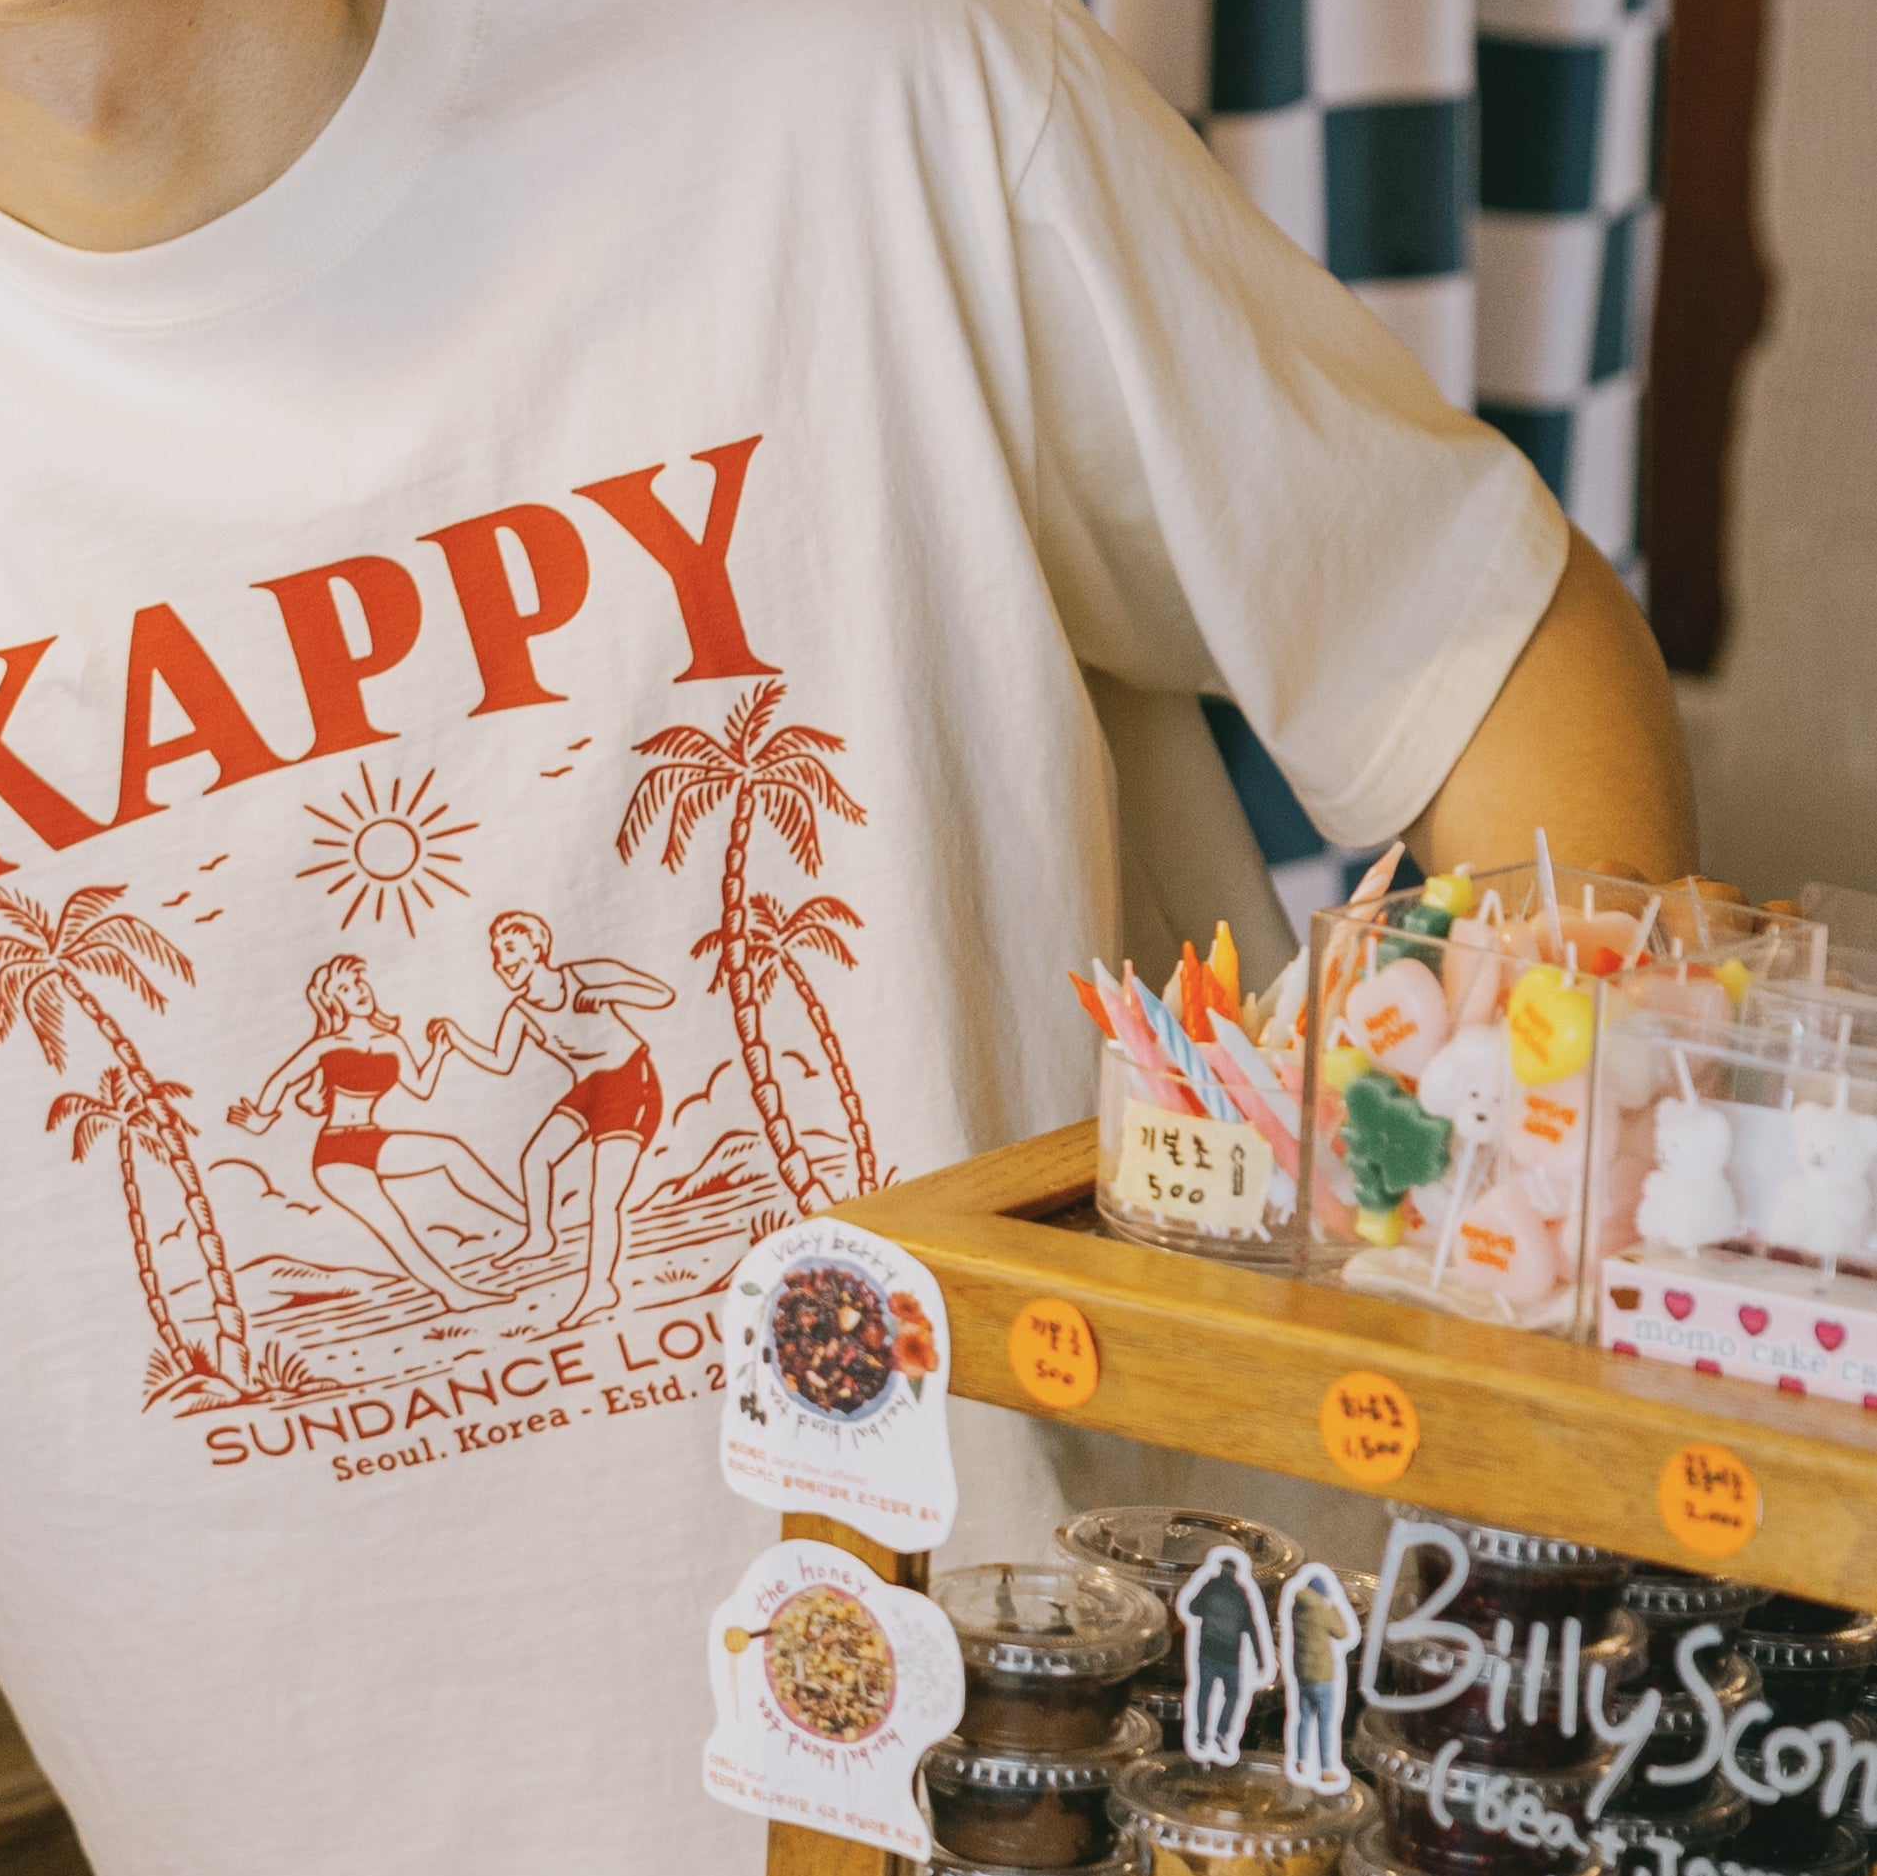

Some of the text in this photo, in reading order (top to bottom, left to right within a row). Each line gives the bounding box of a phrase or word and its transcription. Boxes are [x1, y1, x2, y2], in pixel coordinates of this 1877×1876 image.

[1147, 1172, 1205, 1205] 500
[1633, 1316, 1829, 1375] momo cake
[206, 1341, 595, 1468] SUNDANCE
[453, 1406, 572, 1454] Korea
[755, 1553, 870, 1614] the honey
[1358, 1517, 1662, 1823] Billy
